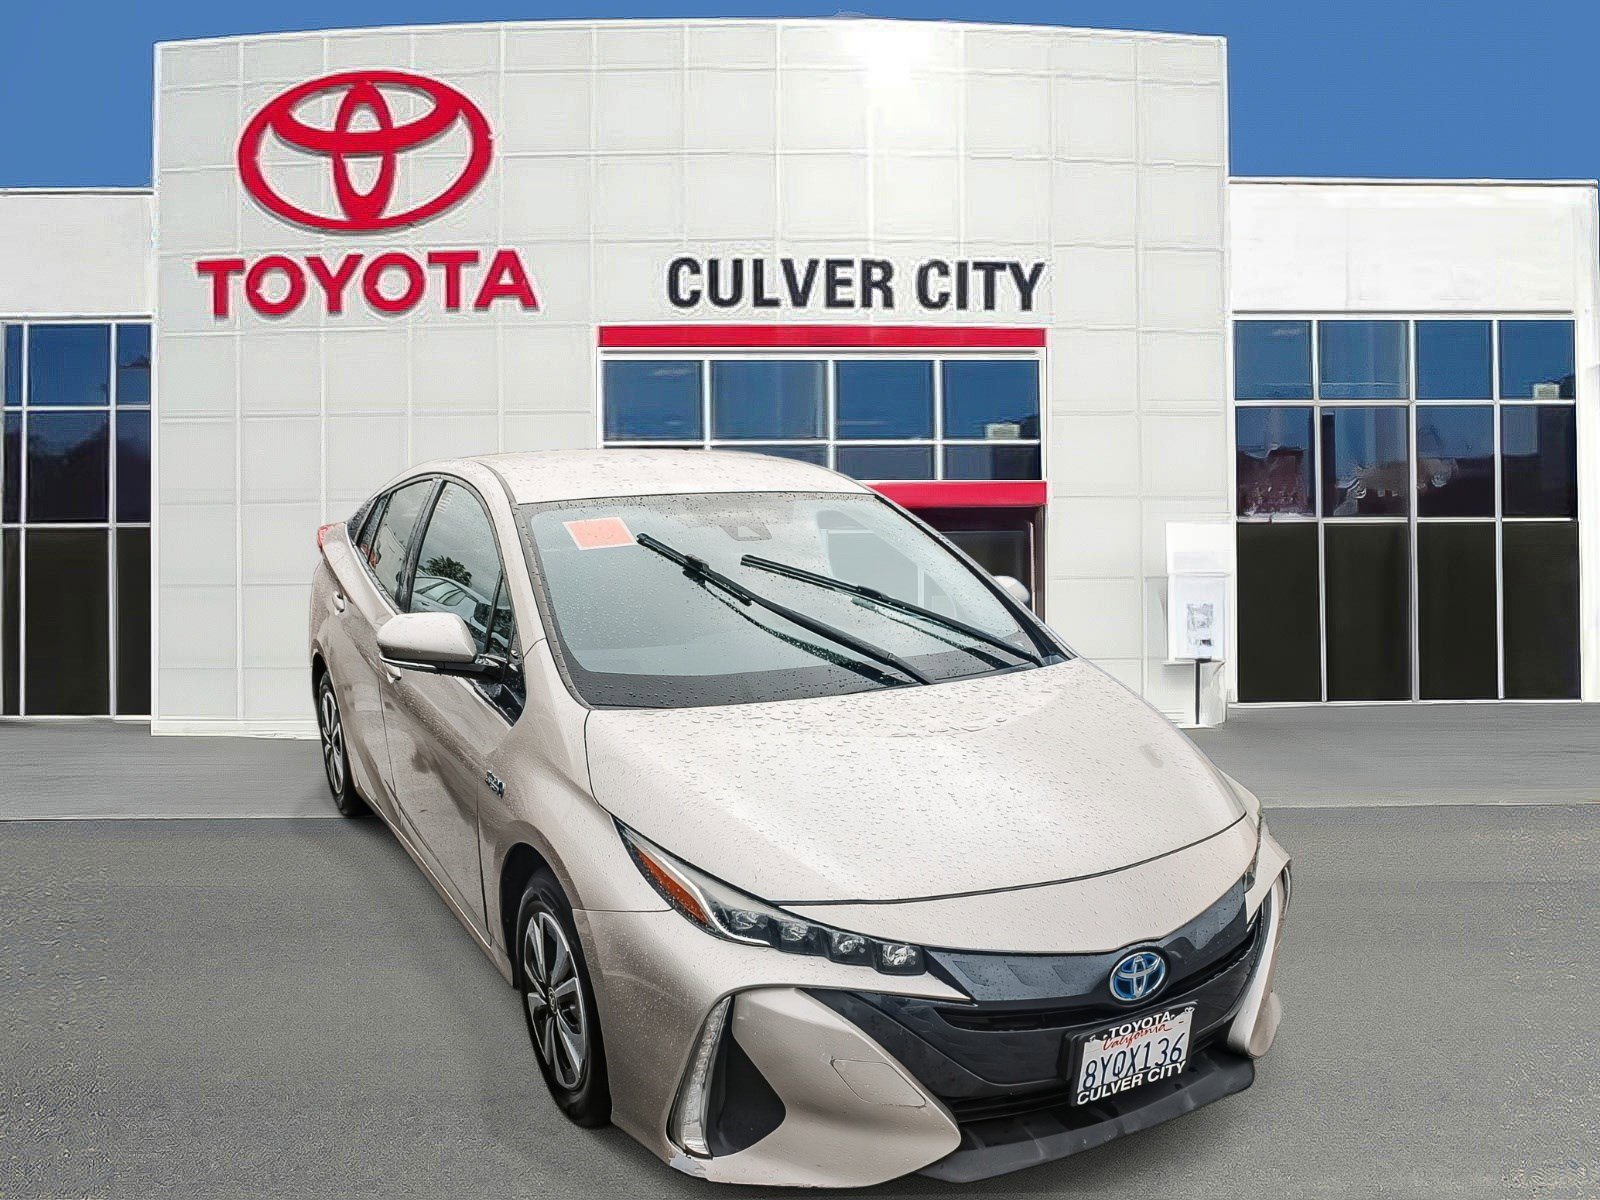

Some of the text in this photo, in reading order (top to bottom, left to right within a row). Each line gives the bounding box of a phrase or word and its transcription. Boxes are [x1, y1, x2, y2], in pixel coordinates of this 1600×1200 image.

[196, 250, 540, 319] TOYOTA
[667, 256, 1046, 312] CULVER CITY
[1109, 1011, 1172, 1038] TOYOTA
[1077, 1060, 1187, 1105] CULVER CITY
[1083, 1032, 1185, 1089] 8YQX136
